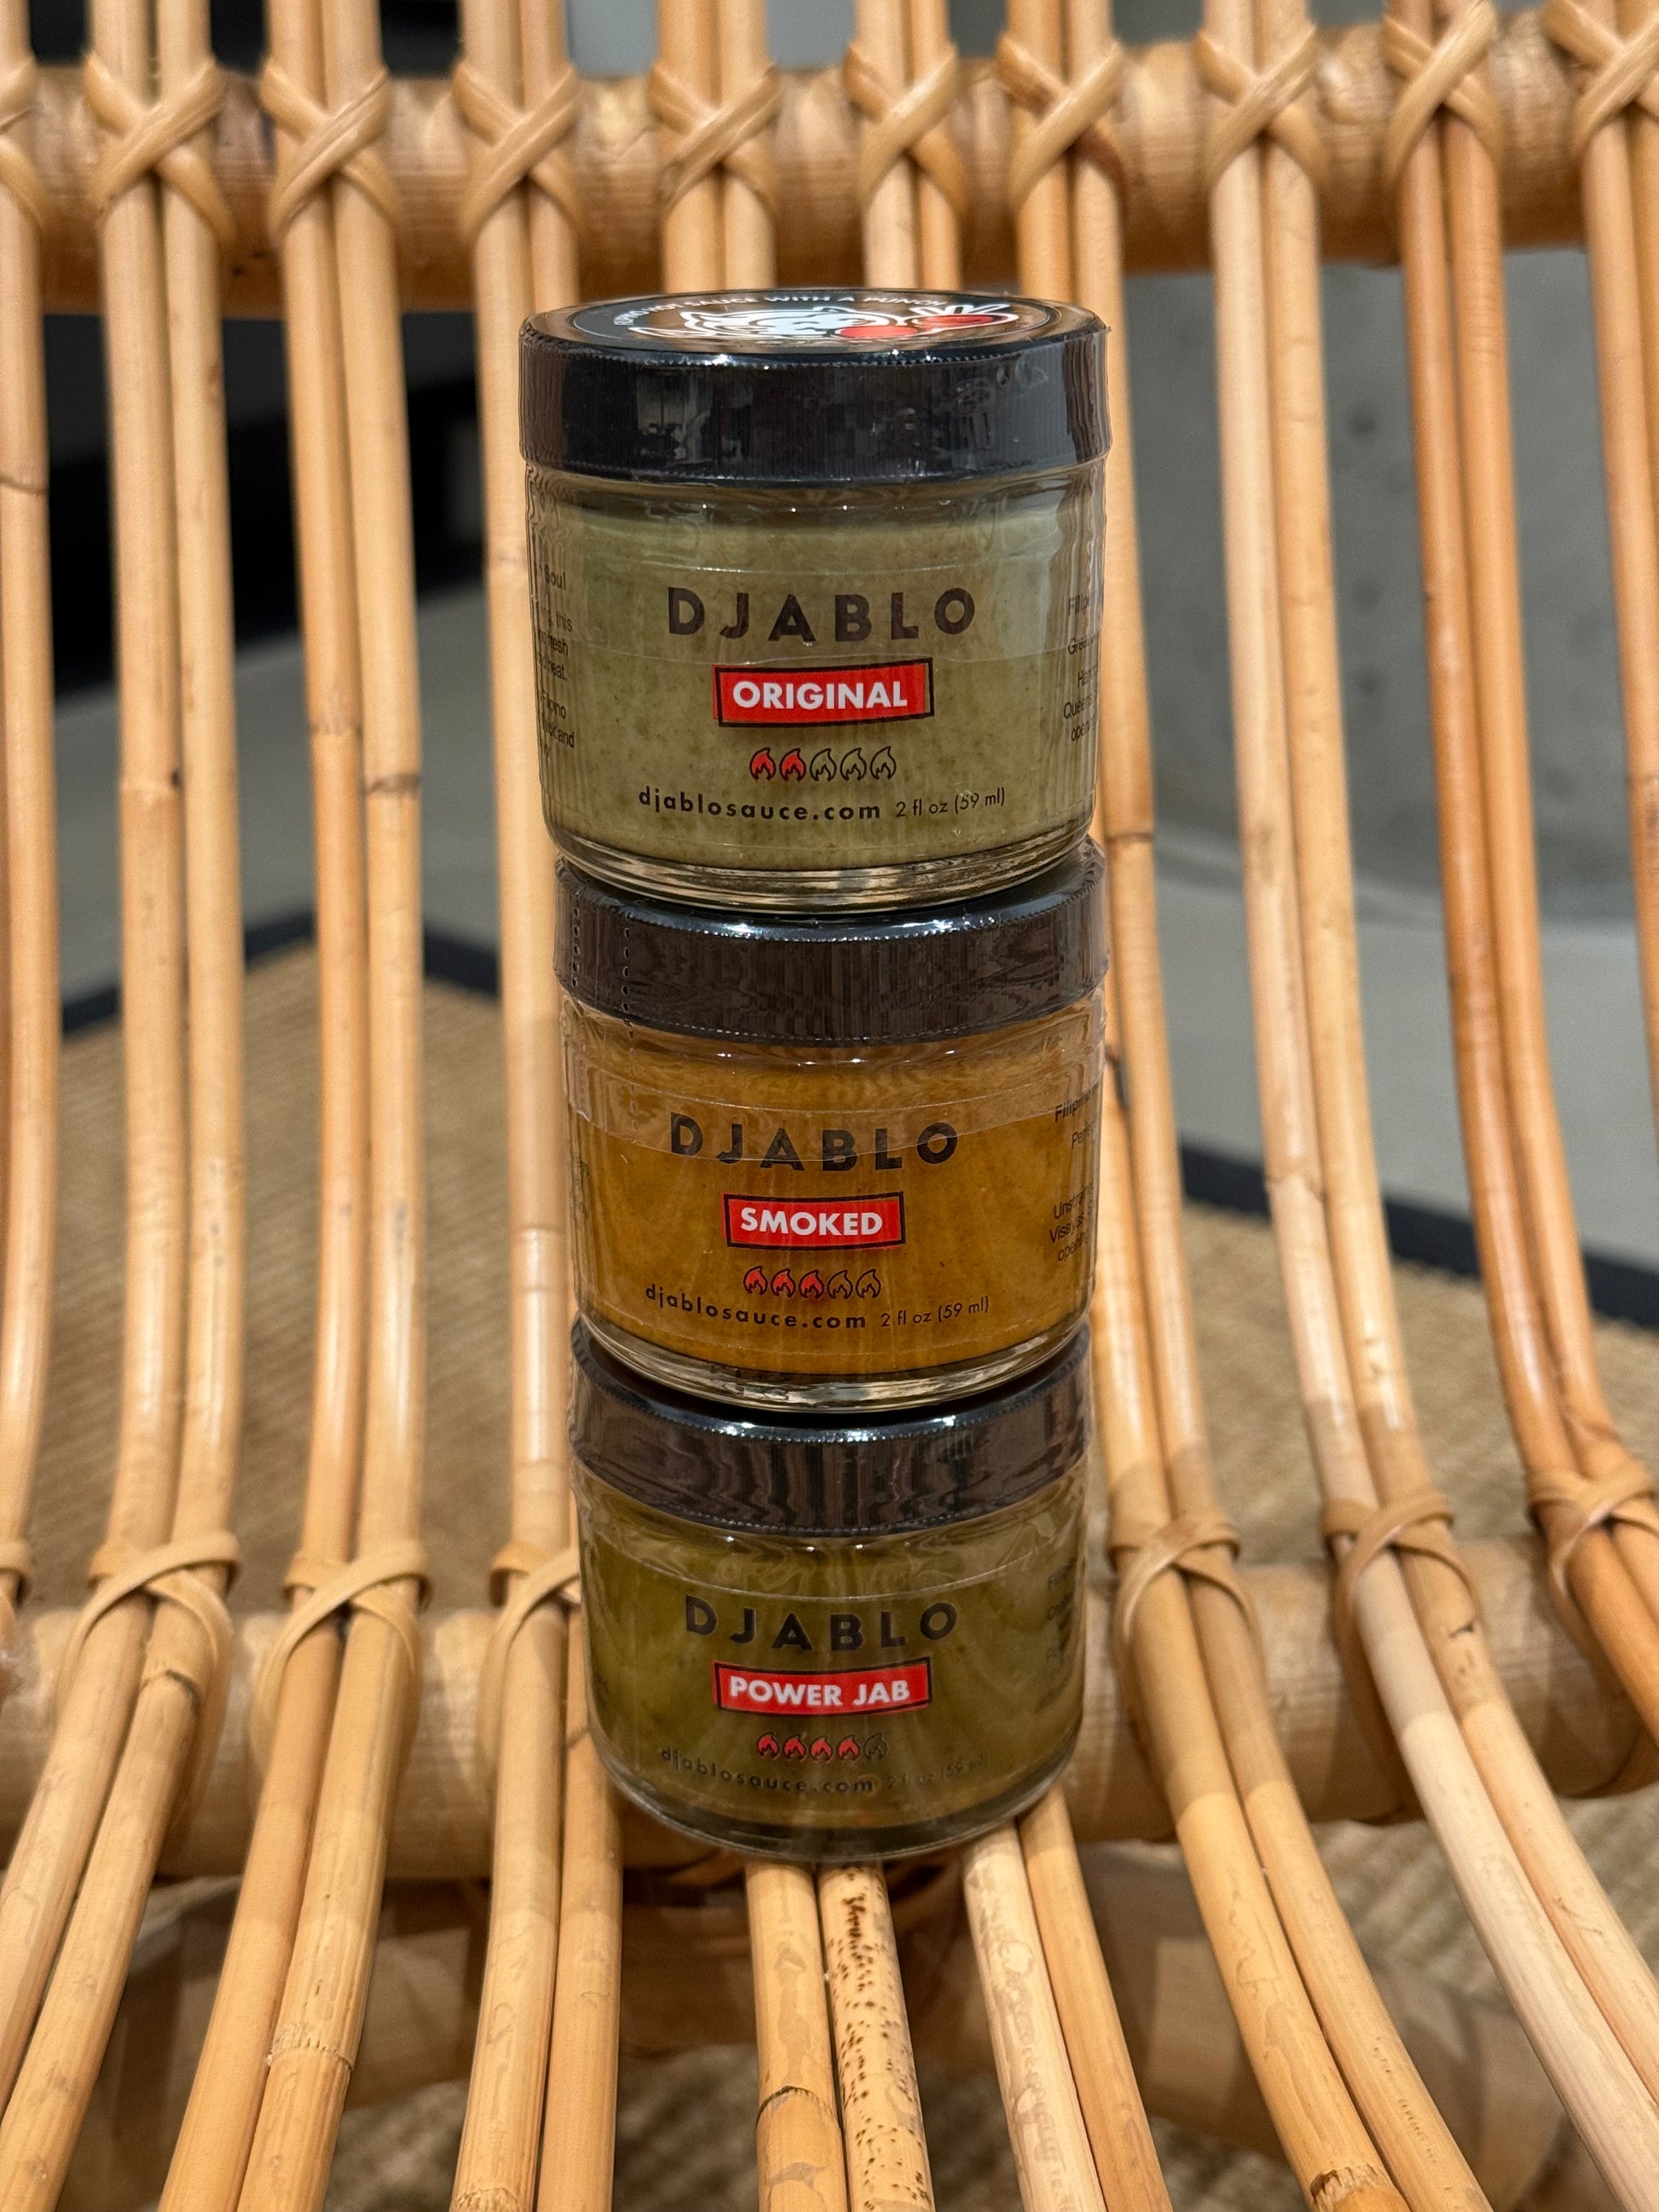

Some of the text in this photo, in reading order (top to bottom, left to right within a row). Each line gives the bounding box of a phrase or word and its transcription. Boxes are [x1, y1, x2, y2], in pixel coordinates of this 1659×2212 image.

[684, 297, 760, 307] SAUCE
[863, 297, 948, 306] PUNCH
[668, 586, 975, 642] DJABLO
[732, 680, 908, 710] ORIGINAL
[558, 731, 575, 748] and
[639, 785, 1005, 821] djablosauce.com 2 fl oz (59 ml)
[670, 1112, 958, 1172] DJABLO
[741, 1207, 883, 1237] SMOKED
[645, 1283, 989, 1329] djablosauce.com 2 fl oz (59 ml)
[685, 1594, 958, 1651] DJABLO
[730, 1676, 910, 1706] POWER JAB
[661, 1747, 873, 1792] djablosauce.com
